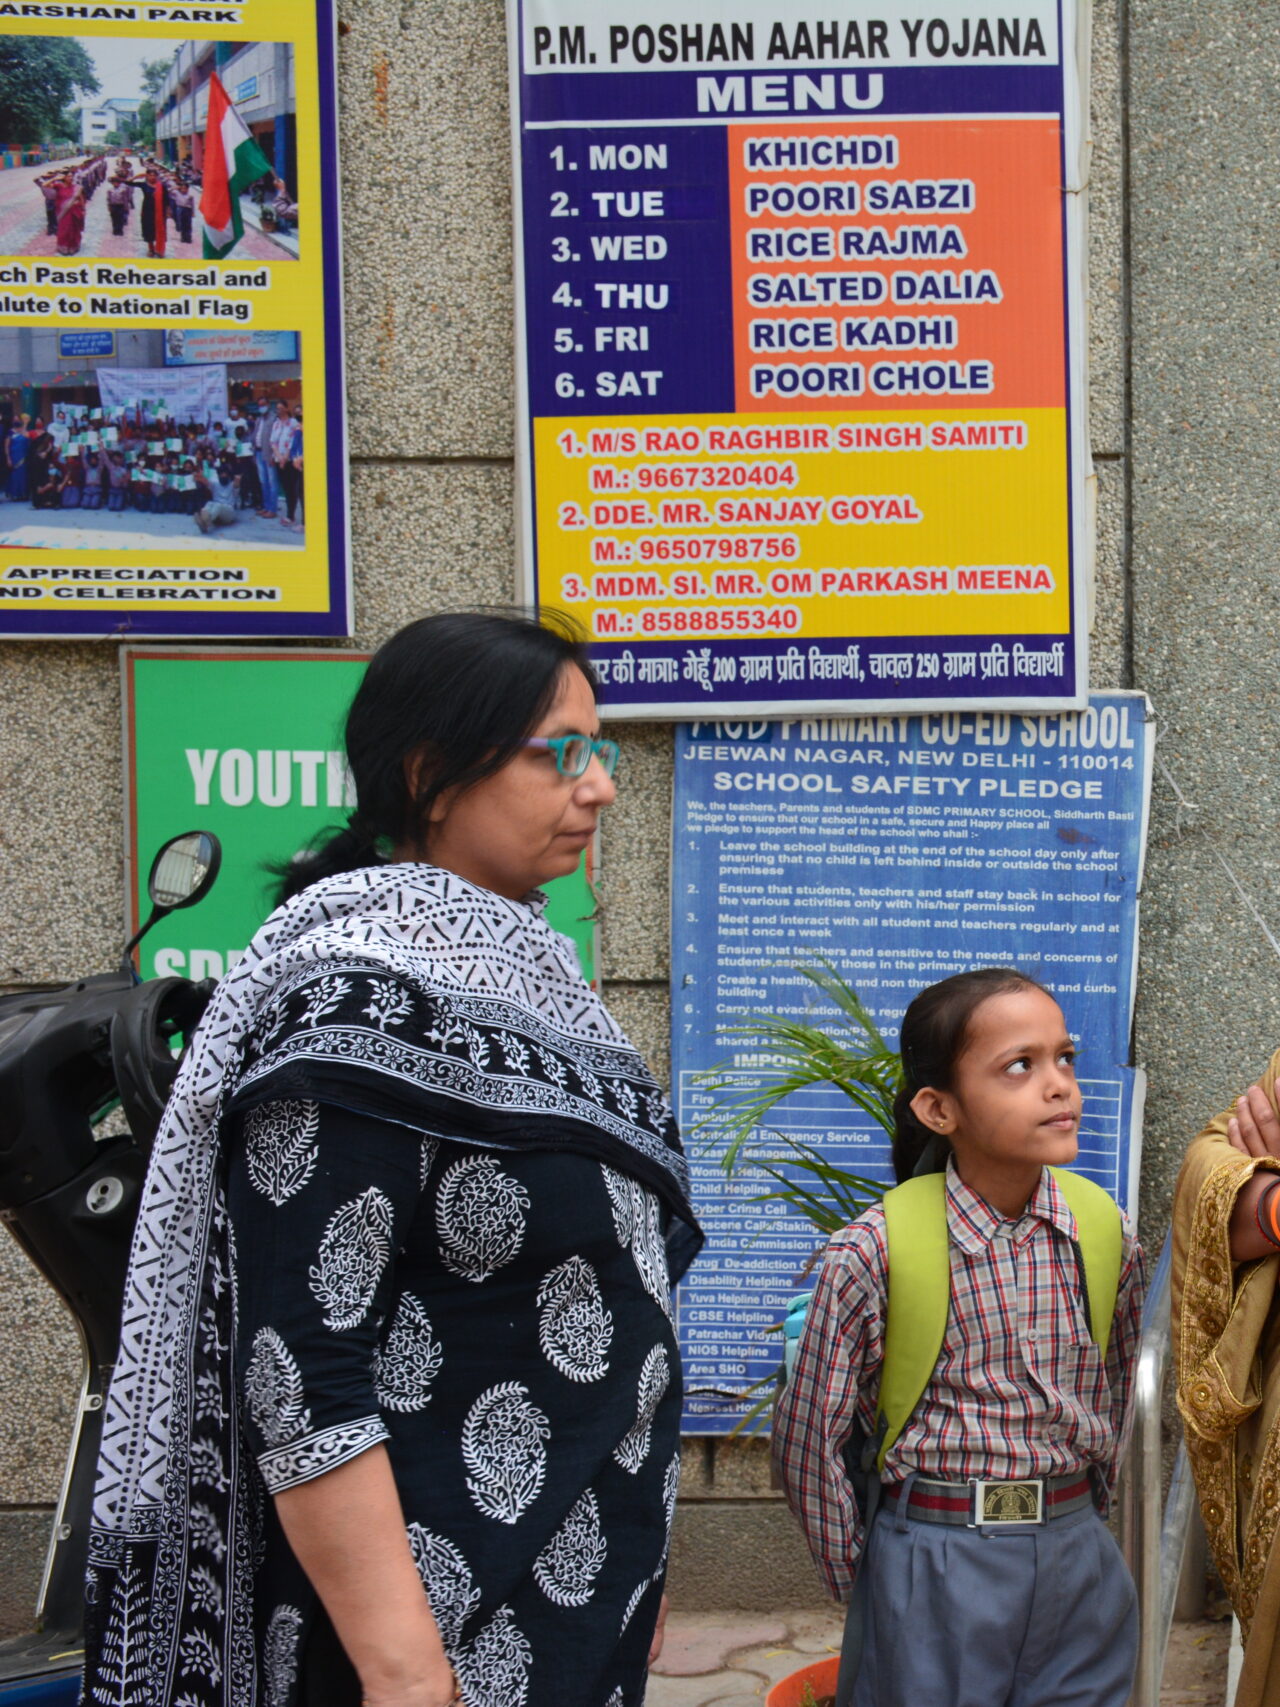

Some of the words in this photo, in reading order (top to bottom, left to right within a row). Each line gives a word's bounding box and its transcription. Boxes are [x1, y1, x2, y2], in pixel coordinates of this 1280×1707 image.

[148, 8, 236, 21] PARK
[533, 25, 596, 65] P.M.
[609, 22, 754, 63] POSHAN
[766, 20, 890, 60] AAHAR
[900, 18, 1046, 57] YOJANA
[696, 73, 884, 111] MENU
[549, 145, 577, 171] 1.
[588, 144, 667, 170] MON
[748, 140, 893, 166] KHICHDI
[550, 191, 579, 216] 2.
[591, 190, 664, 217] TUE
[749, 186, 855, 211] POORI
[868, 184, 970, 209] SABZI
[551, 236, 580, 262] 3.
[590, 234, 667, 260] WED
[751, 232, 830, 256] RICE
[843, 230, 962, 254] RAJMA
[35, 266, 88, 284] Past
[96, 268, 217, 285] Rehearsal
[225, 270, 266, 286] and
[752, 276, 882, 302] SALTED
[895, 275, 998, 299] DALIA
[551, 282, 582, 307] 4.
[594, 282, 668, 308] THU
[57, 298, 82, 313] to
[90, 297, 190, 314] National
[198, 299, 248, 320] Flag
[554, 327, 583, 352] 5.
[594, 326, 648, 351] FRI
[753, 323, 832, 347] RICE
[845, 320, 952, 345] KADHI
[554, 372, 584, 397] 6.
[595, 370, 663, 396] SAT
[754, 367, 859, 392] POORI
[873, 365, 988, 390] CHOLE
[561, 434, 582, 452] 1.
[592, 432, 636, 452] M/S
[646, 431, 699, 450] RAO
[709, 429, 828, 449] RAGHBIR
[838, 427, 921, 447] SINGH
[932, 425, 1022, 445] SAMITI
[593, 469, 628, 488] M.:
[638, 466, 794, 487] 9667320404
[563, 506, 584, 525] 2.
[594, 504, 652, 524] DDE.
[662, 503, 709, 522] MR.
[719, 501, 821, 521] SANJAY
[831, 500, 917, 519] GOYAL
[595, 541, 630, 560] M.:
[639, 537, 796, 559] 9650798756
[6, 568, 243, 580] APPRECIATION
[566, 578, 586, 597] 3.
[595, 577, 664, 596] MDM.
[674, 575, 706, 594] SI.
[716, 574, 762, 593] MR.
[771, 573, 811, 592] OM
[821, 571, 947, 591] PARKASH
[957, 570, 1050, 589] MEENA
[53, 587, 276, 599] CELEBRATION
[596, 613, 632, 632] M.:
[642, 610, 797, 631] 8588855340
[611, 649, 635, 683] की
[713, 656, 737, 682] 200
[739, 655, 775, 683] ग्राम
[776, 646, 806, 682] प्रति
[868, 652, 914, 678] चावल
[915, 652, 940, 678] 250
[941, 651, 977, 679] ग्राम
[978, 642, 1010, 679] प्रति
[921, 712, 1010, 747] CO-ED
[1020, 706, 1135, 749] SCHOOL
[682, 745, 786, 761] JEEWAN
[794, 747, 890, 765] NAGAR,
[898, 750, 954, 765] NEW
[962, 752, 1035, 768] DELHI
[1057, 754, 1134, 770] 110014
[713, 772, 842, 792] SCHOOL
[850, 775, 971, 795] SAFETY
[979, 778, 1102, 799] PLEDGE
[708, 801, 726, 810] the
[778, 802, 820, 812] Parents
[821, 804, 842, 813] and
[844, 804, 890, 814] students
[892, 805, 904, 814] of
[906, 805, 940, 815] SDMC
[943, 806, 996, 816] PRIMARY
[1053, 809, 1105, 819] Siddharth
[1107, 810, 1134, 821] Basti
[688, 840, 700, 850] 1.
[719, 840, 757, 850] Leave
[759, 841, 780, 851] the
[782, 842, 826, 852] school
[828, 842, 880, 855] building
[883, 844, 896, 854] at
[898, 844, 919, 855] the
[921, 845, 946, 855] end
[948, 845, 962, 855] of
[964, 846, 985, 856] the
[988, 847, 1031, 857] school
[1033, 848, 1057, 860] day
[1060, 849, 1087, 861] only
[1090, 848, 1120, 859] after
[691, 1093, 714, 1104] Fire
[690, 1182, 721, 1194] Child
[724, 1183, 771, 1195] Helpline
[689, 1275, 743, 1288] Disability
[745, 1276, 793, 1288] Helpline
[689, 1311, 724, 1322] CBSE
[727, 1312, 774, 1323] Helpline
[687, 1344, 718, 1355] NIOS
[721, 1345, 768, 1357] Helpline
[688, 1363, 715, 1374] Area
[718, 1363, 745, 1374] SHO
